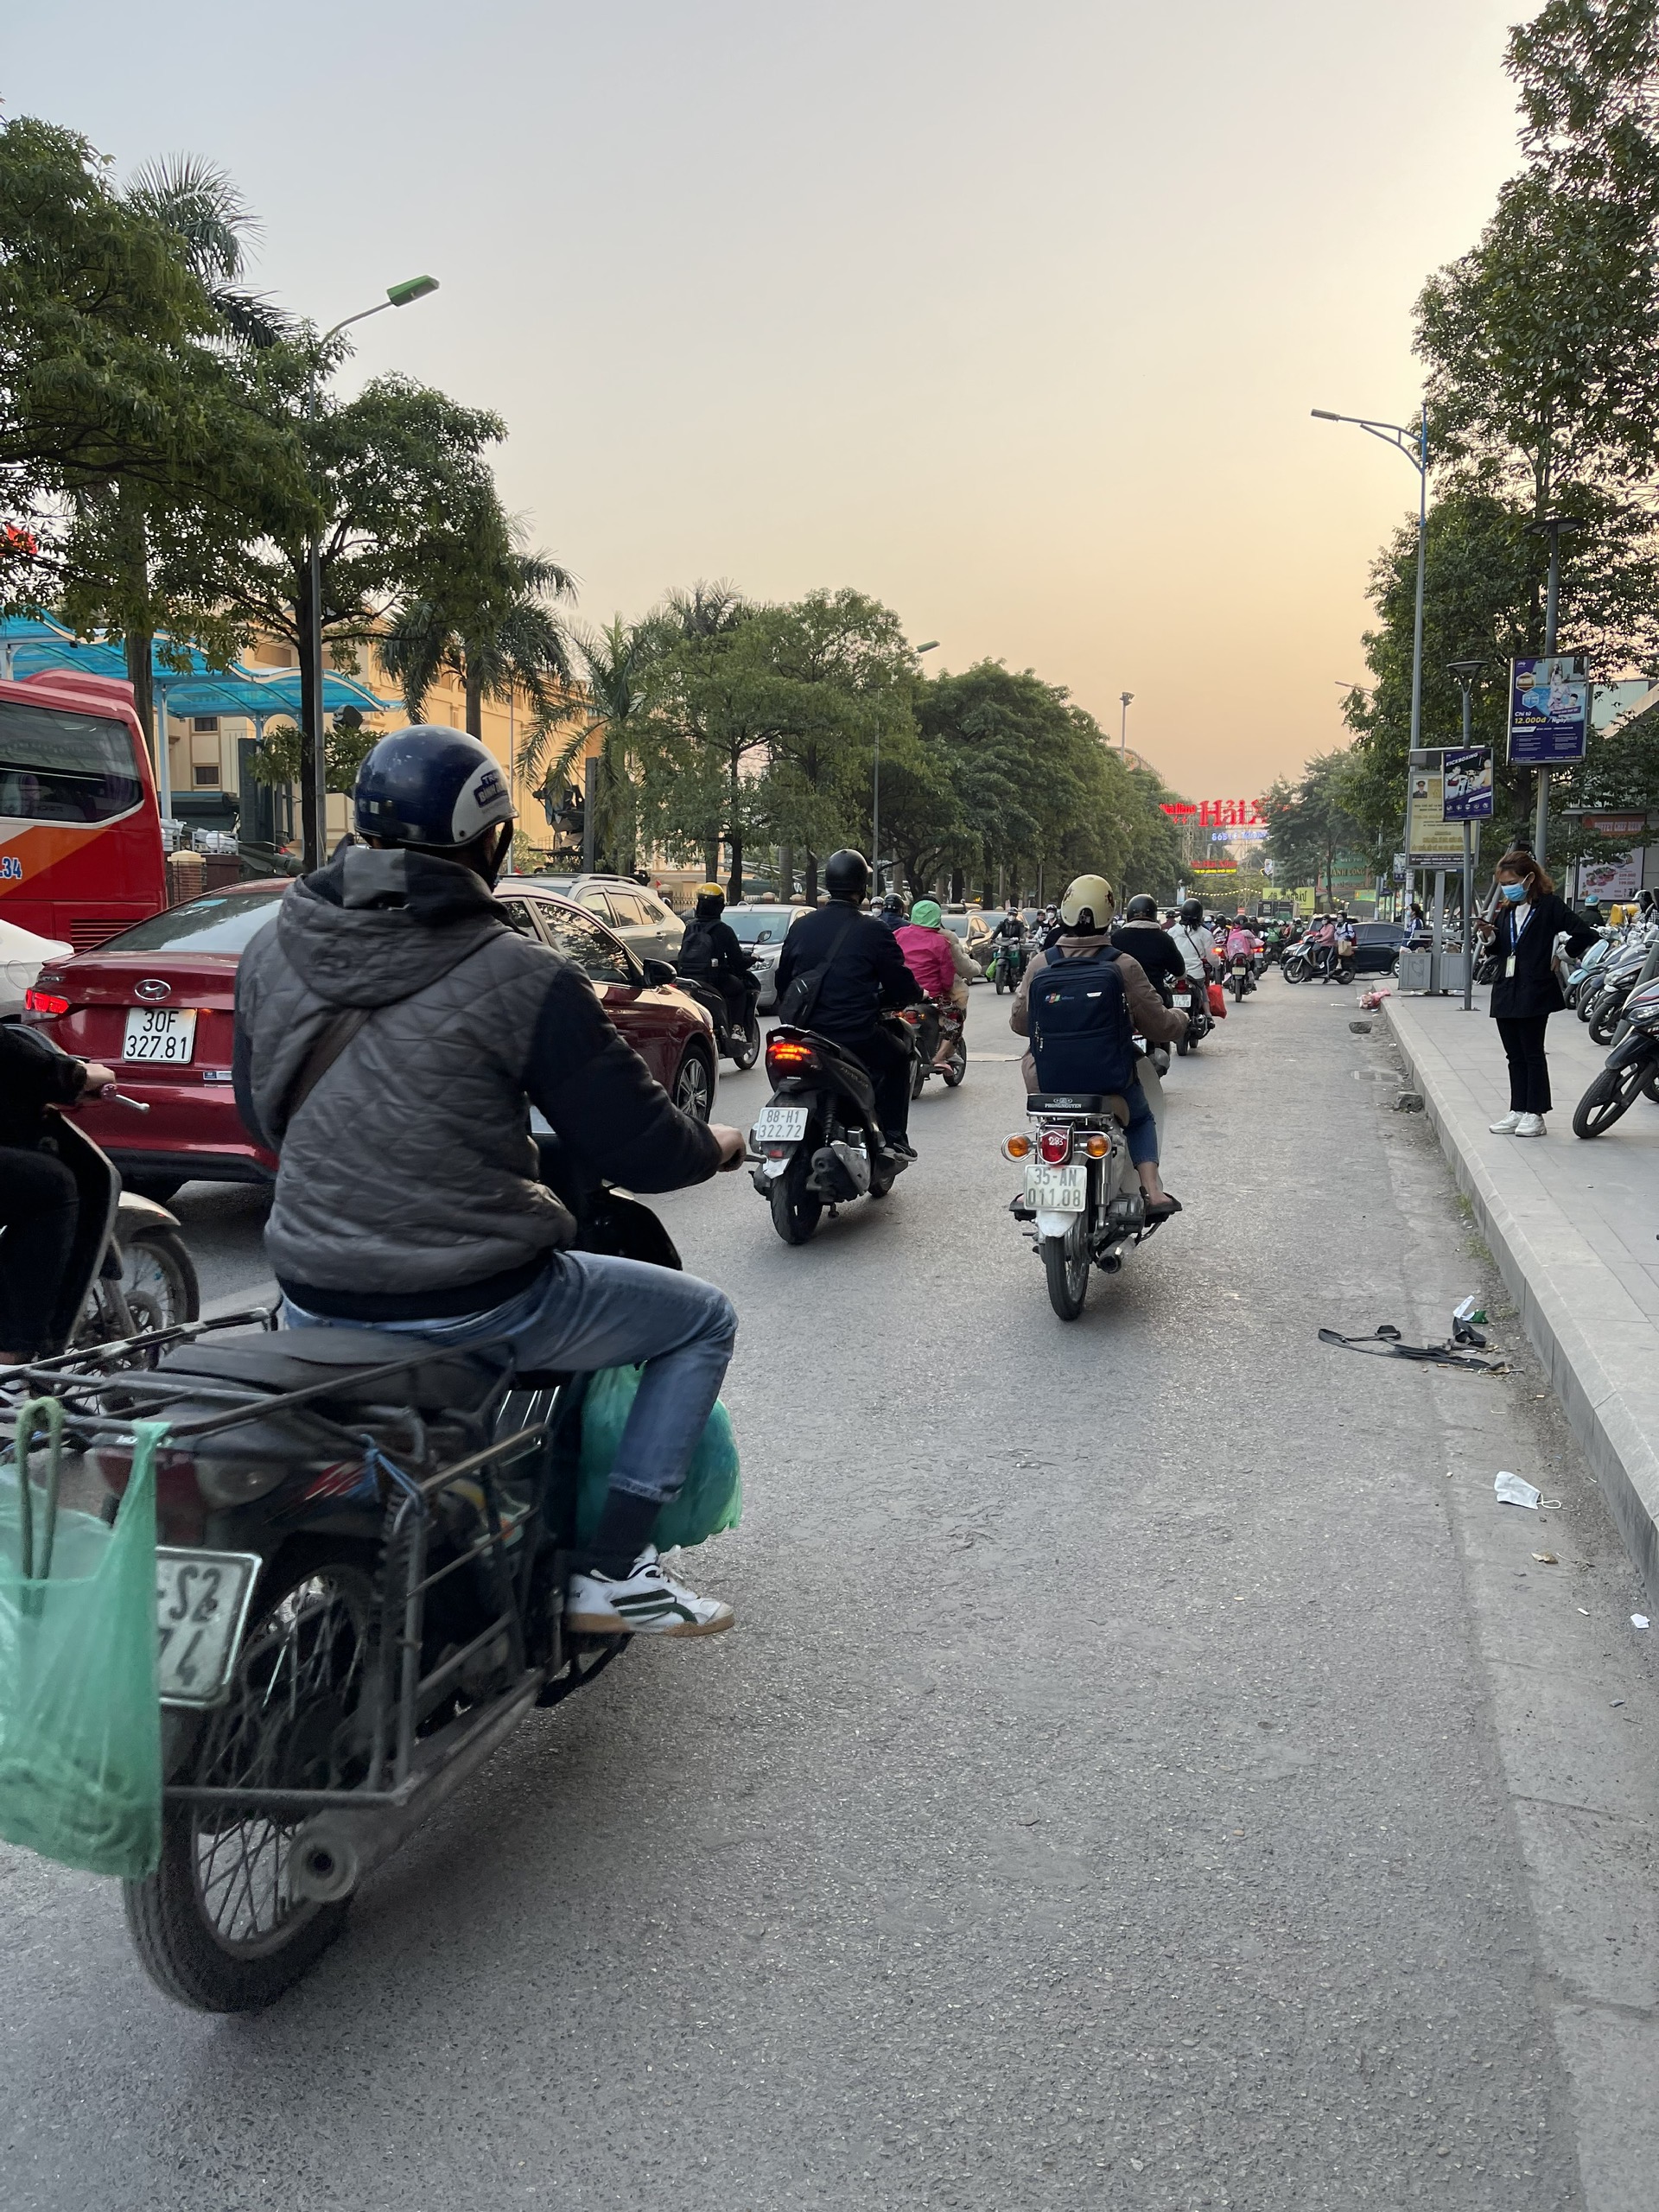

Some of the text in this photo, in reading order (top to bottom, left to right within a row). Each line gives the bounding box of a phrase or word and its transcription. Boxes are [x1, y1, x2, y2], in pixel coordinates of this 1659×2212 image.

[1446, 752, 1478, 767] KICKBOXING
[1198, 799, 1245, 827] Hải
[143, 1011, 179, 1033] 30F
[125, 1035, 188, 1059] 327.81
[766, 1109, 800, 1123] 88-H1
[760, 1124, 802, 1139] 322.72
[1034, 1168, 1077, 1186] 35-AN
[1027, 1188, 1081, 1208] 011.08
